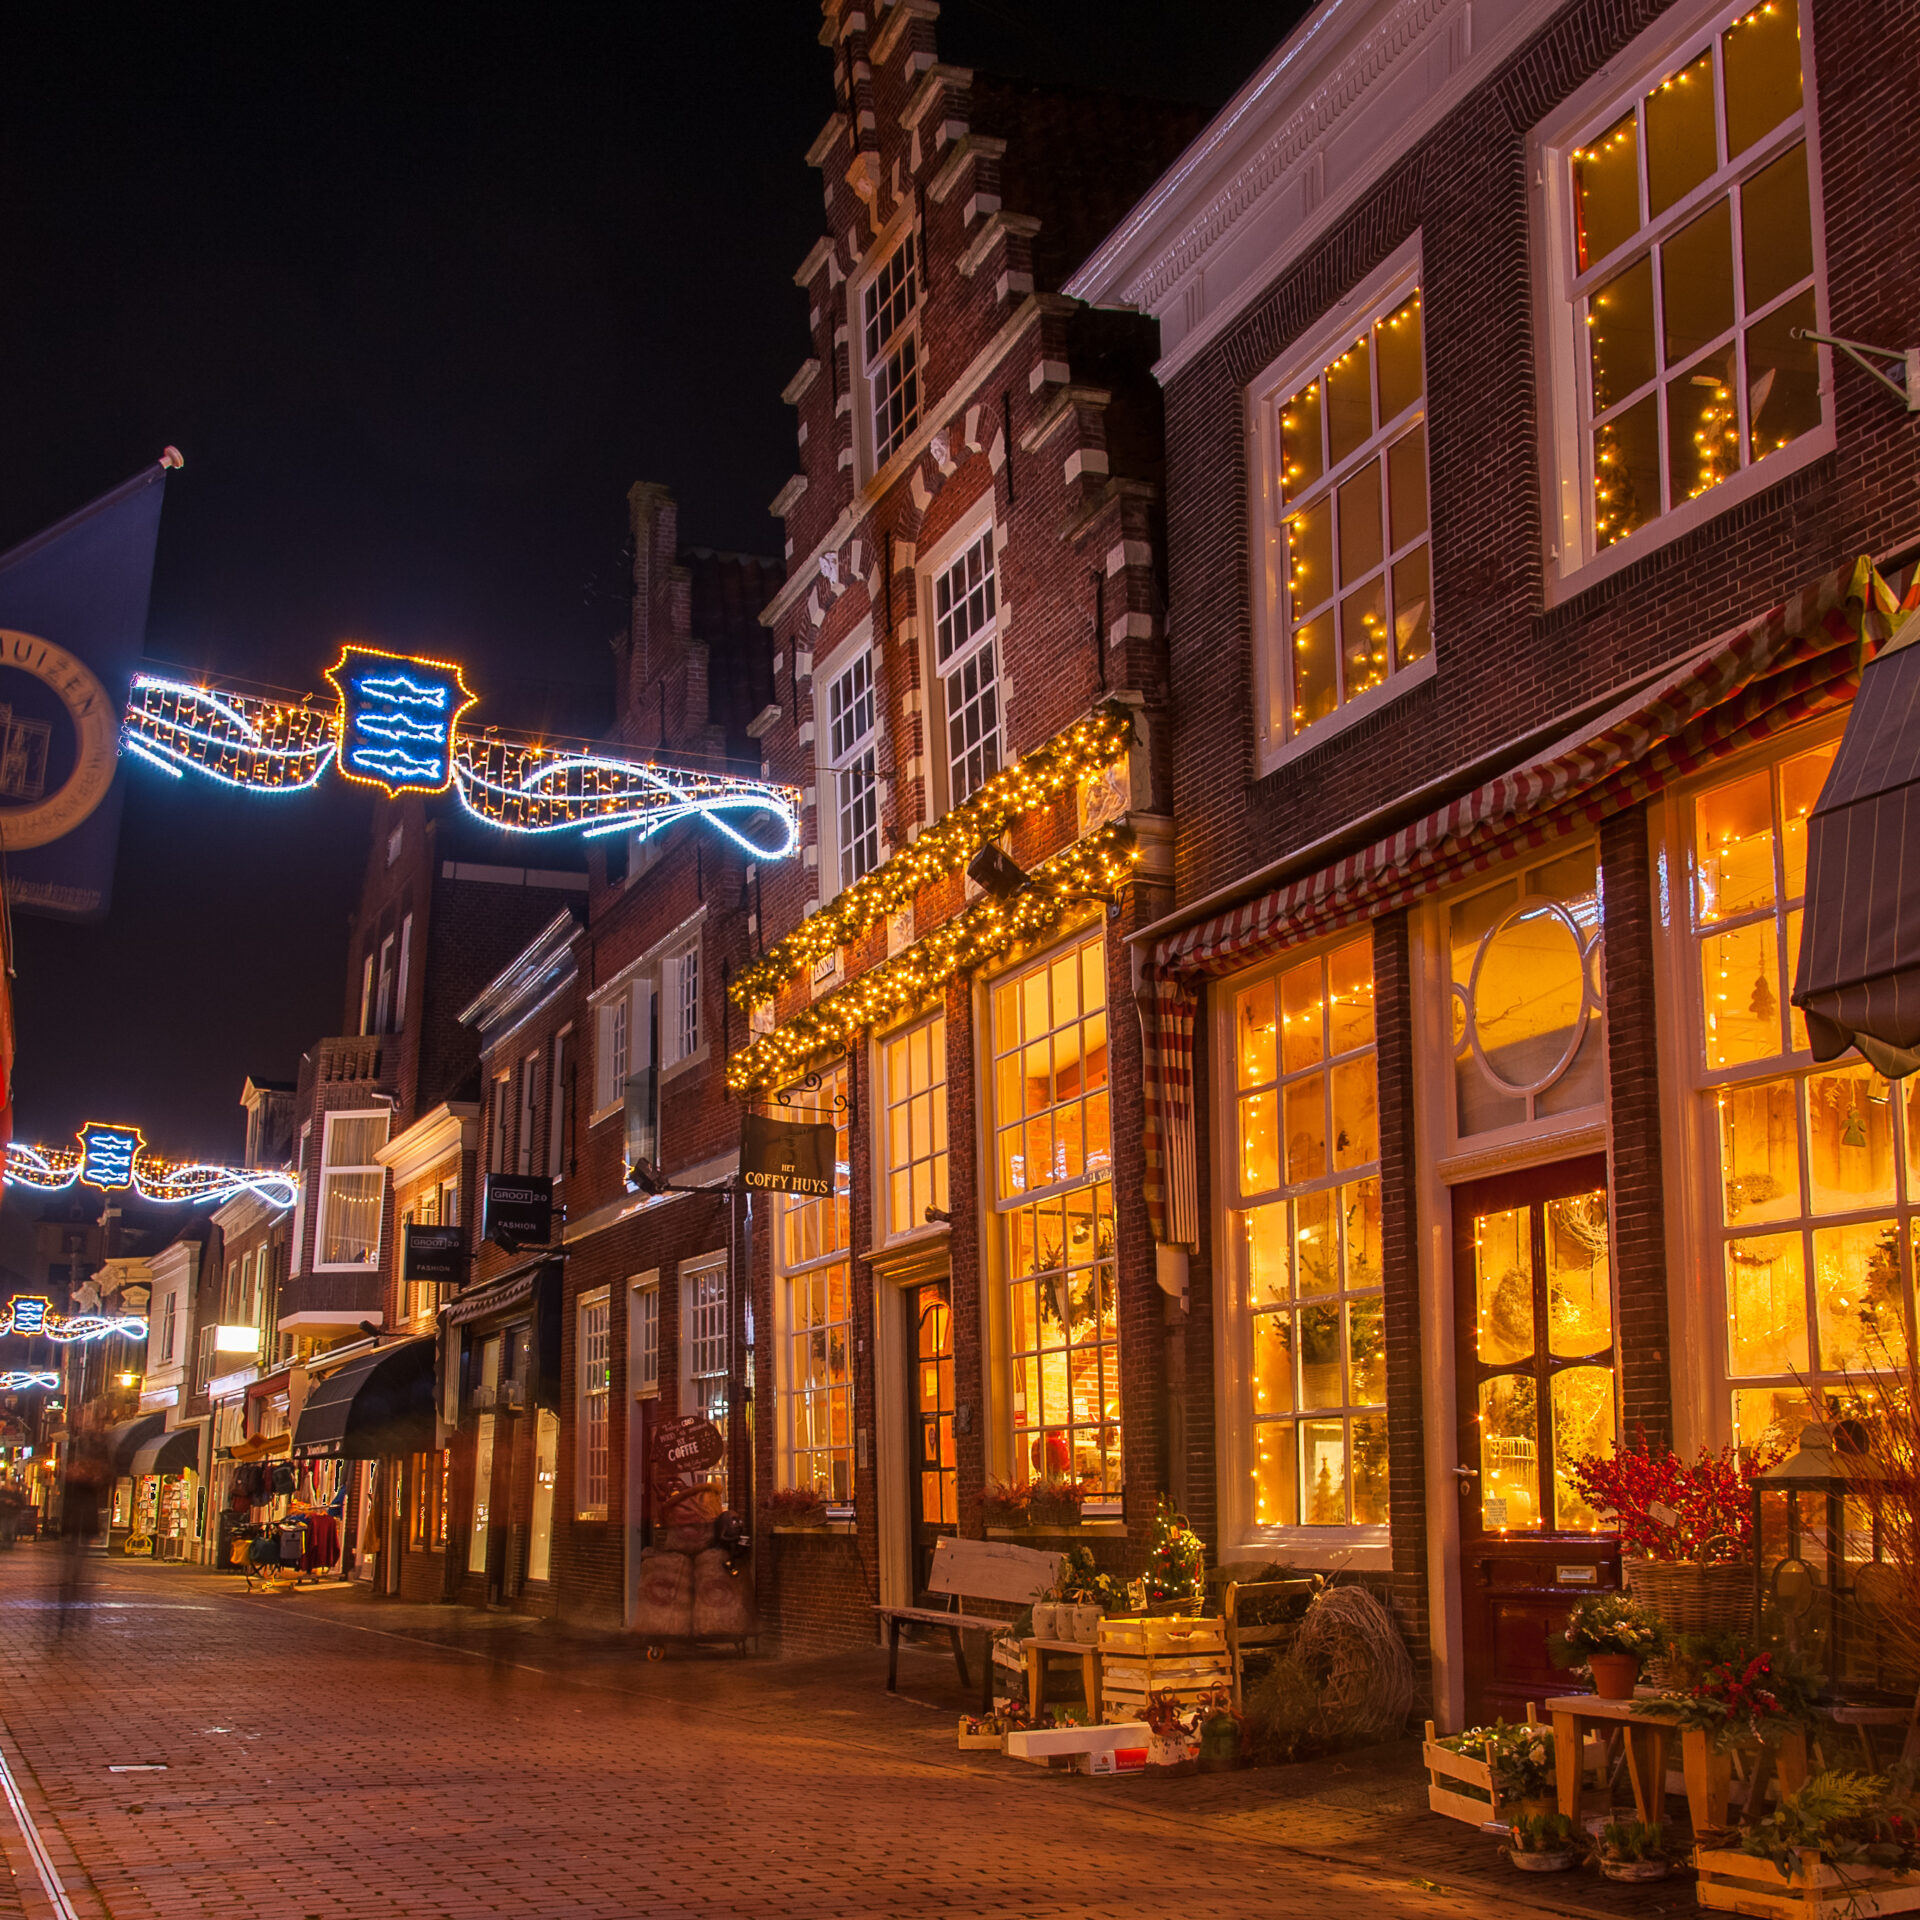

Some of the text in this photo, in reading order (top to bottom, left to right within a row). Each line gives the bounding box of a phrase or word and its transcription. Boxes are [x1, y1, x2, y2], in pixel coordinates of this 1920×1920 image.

[781, 1163, 796, 1173] HET
[745, 1171, 828, 1194] COFFY HUYS
[494, 1190, 548, 1202] GROOT 2.0
[498, 1220, 537, 1231] FASHION
[413, 1238, 460, 1248] GROOT 2.0
[416, 1264, 451, 1273] FASHION
[668, 1441, 699, 1462] COFFEE
